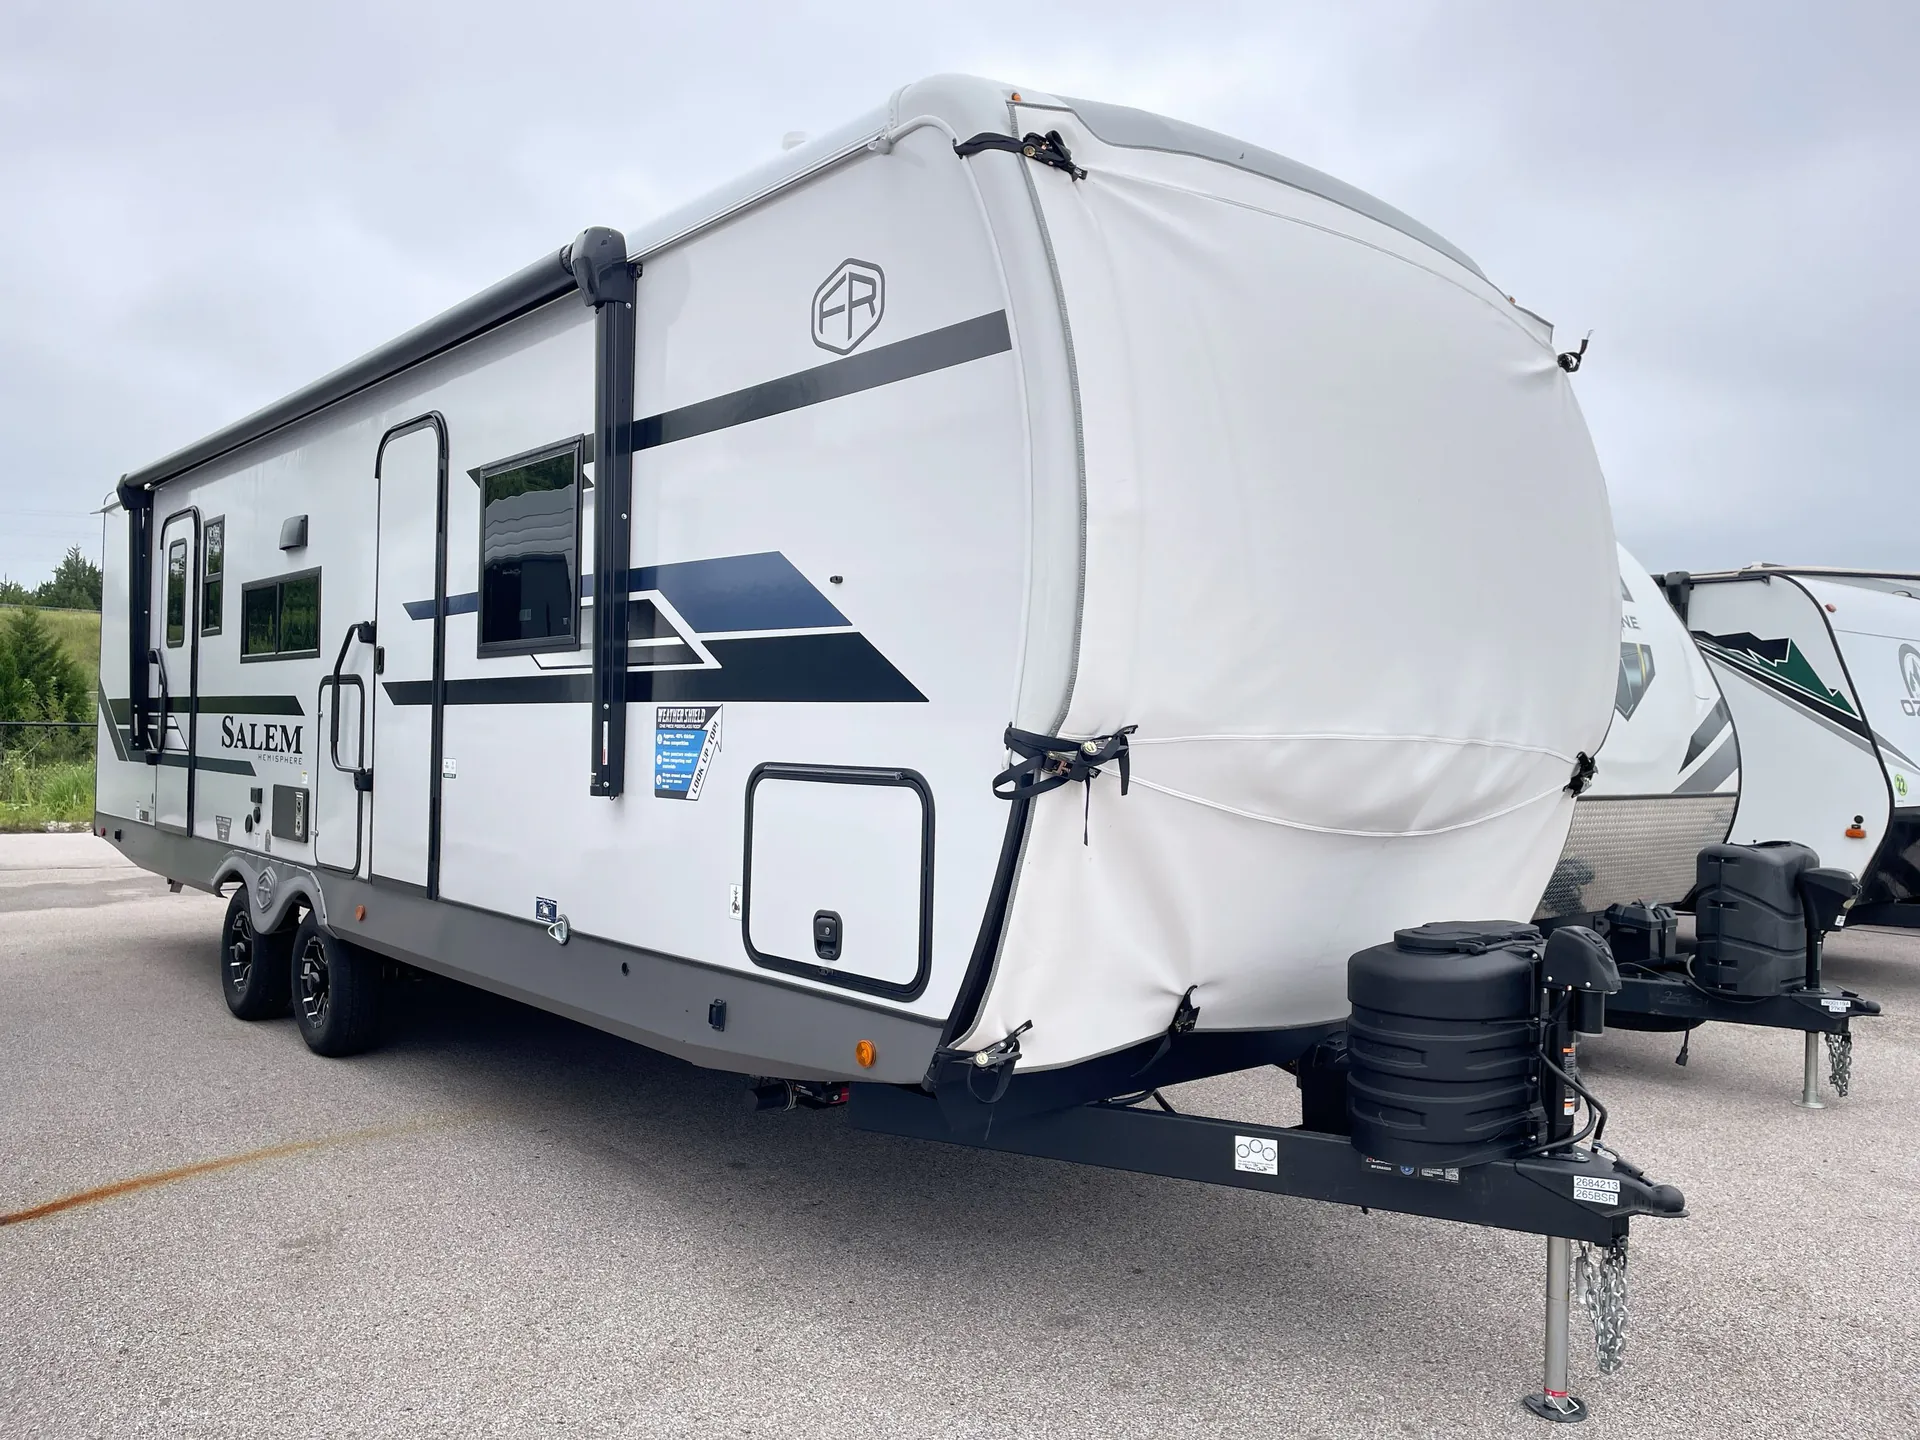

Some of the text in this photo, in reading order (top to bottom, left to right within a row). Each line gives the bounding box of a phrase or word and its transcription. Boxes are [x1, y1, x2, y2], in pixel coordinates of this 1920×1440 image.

[657, 708, 706, 723] WEATHER SHIELD
[257, 753, 303, 765] HEMISPHERE
[692, 721, 719, 794] LOOK UP TOP!
[1576, 1177, 1618, 1190] 2684213
[1576, 1189, 1616, 1203] 265BSR
